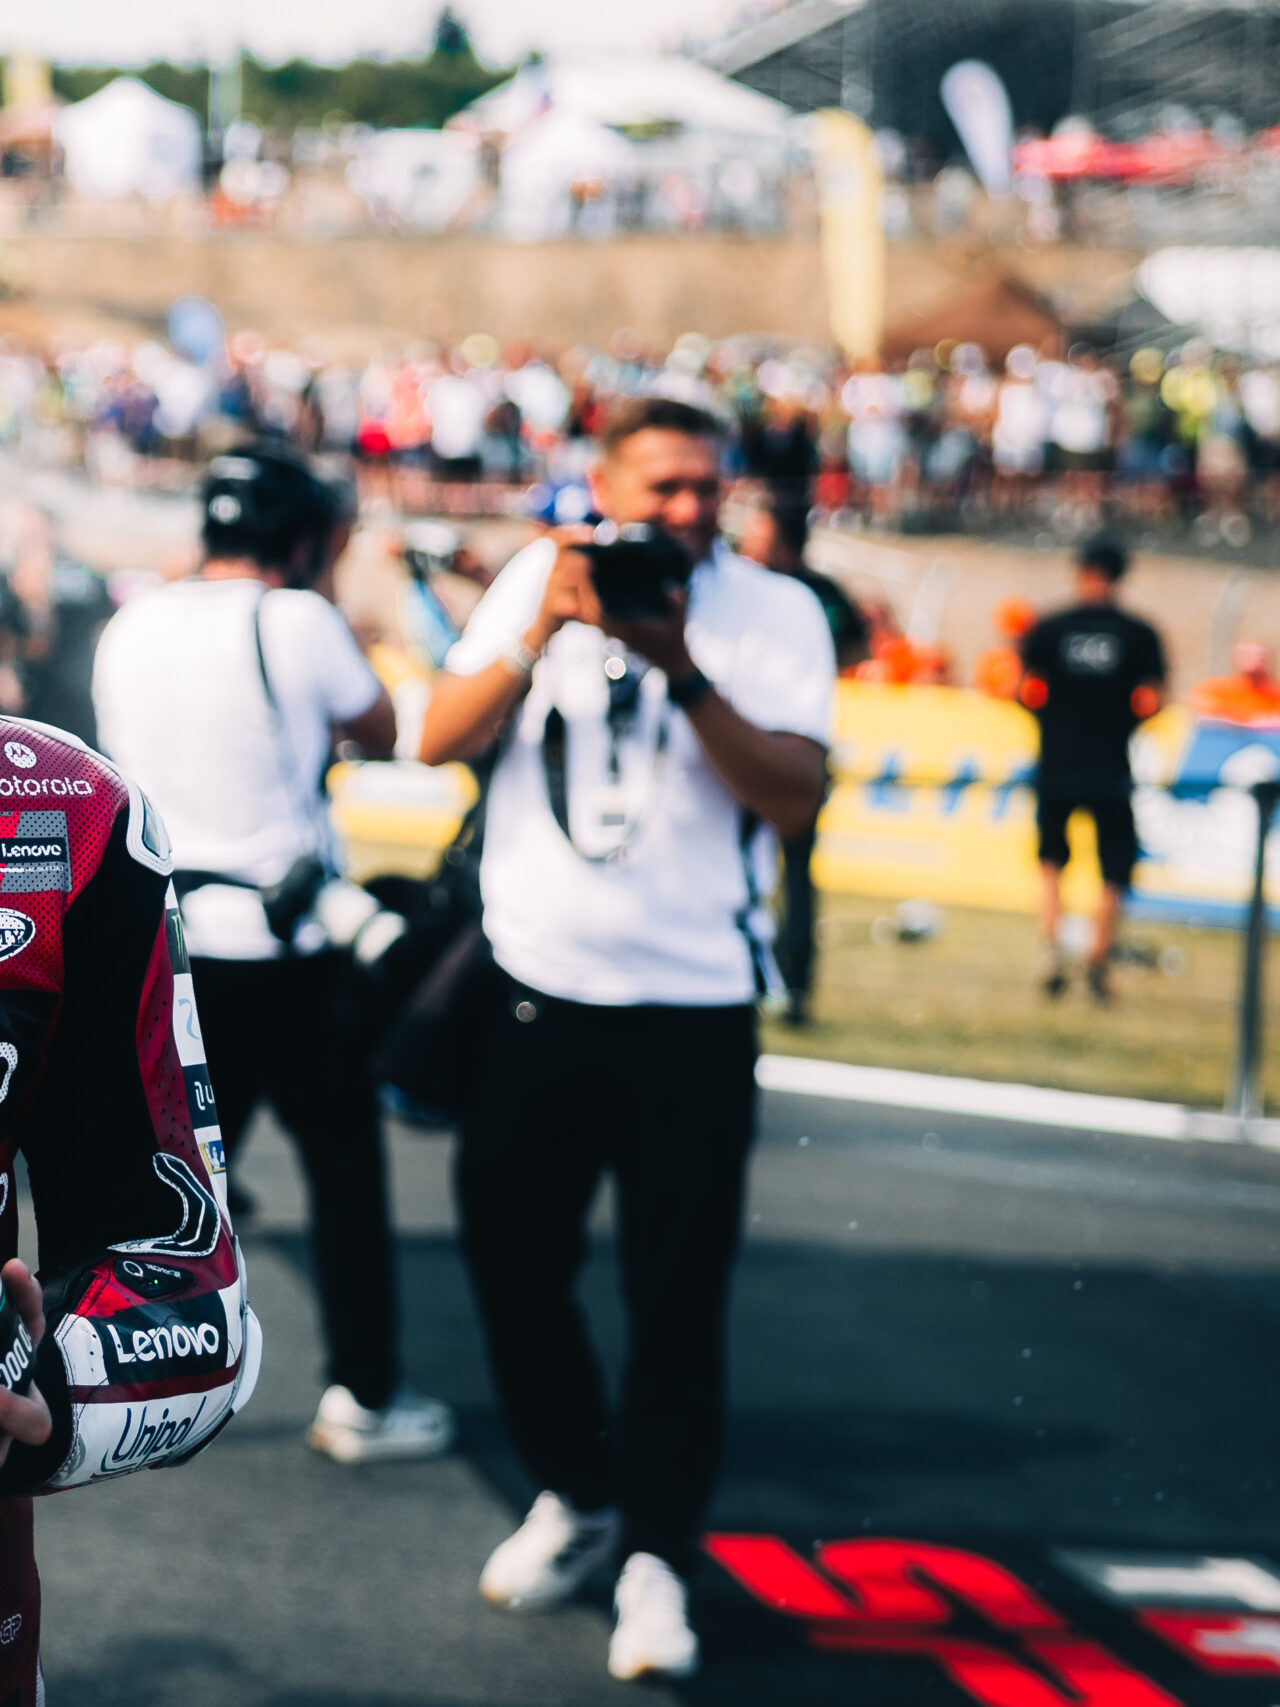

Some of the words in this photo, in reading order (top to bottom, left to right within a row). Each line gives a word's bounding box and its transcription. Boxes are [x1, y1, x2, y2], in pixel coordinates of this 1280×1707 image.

[1, 842, 62, 858] Lenovo
[106, 1322, 220, 1364] Lenovo
[111, 1395, 207, 1469] Unipol
